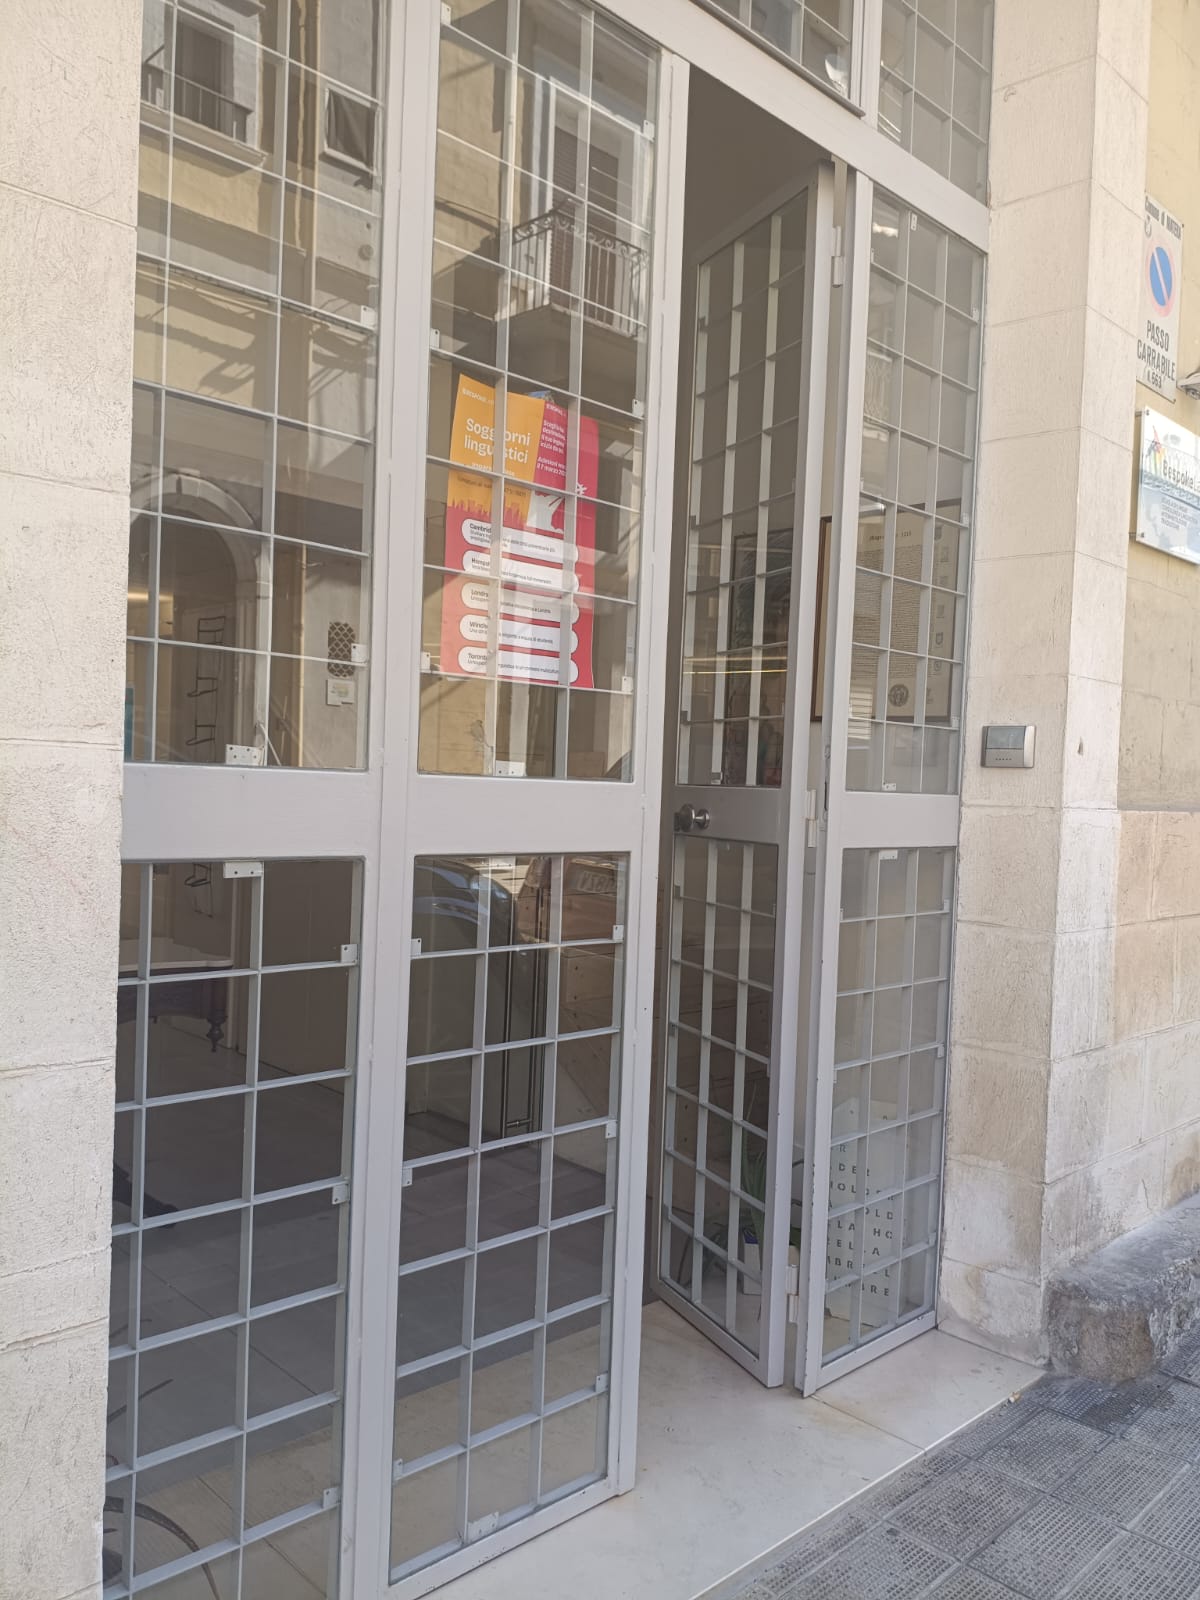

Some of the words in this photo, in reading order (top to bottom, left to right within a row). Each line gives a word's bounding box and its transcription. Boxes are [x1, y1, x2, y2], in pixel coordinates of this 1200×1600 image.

[1146, 320, 1170, 352] PASSO
[1136, 339, 1176, 381] CARRABILE
[466, 418, 531, 446] Soggorni
[464, 435, 529, 464] lingustici
[469, 522, 492, 534] Cambrid
